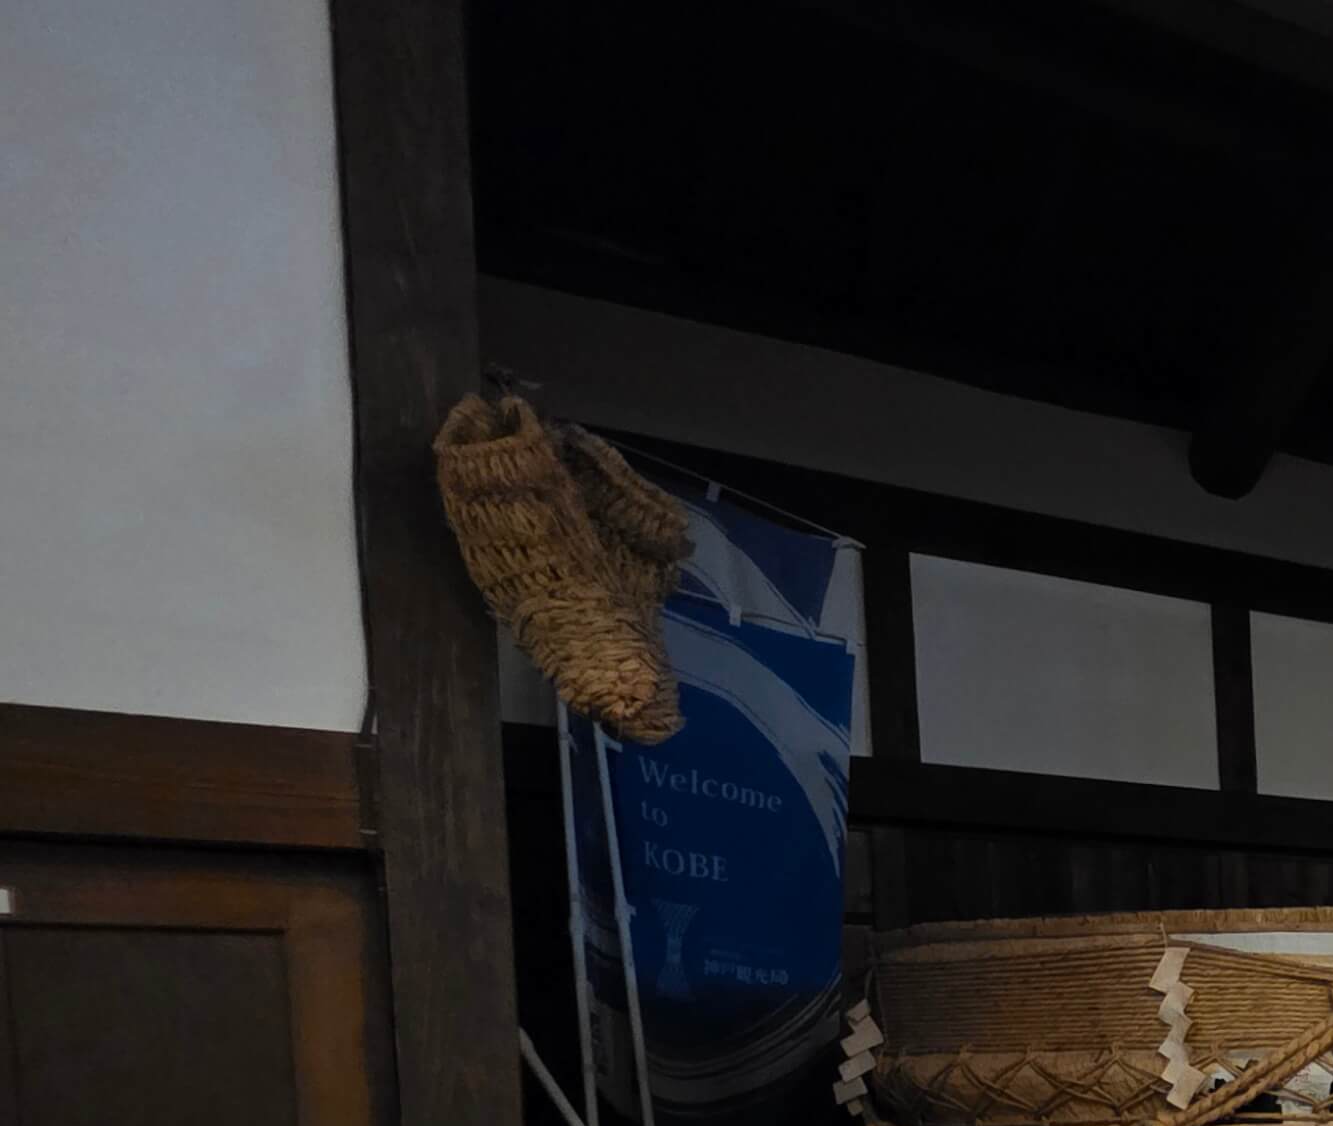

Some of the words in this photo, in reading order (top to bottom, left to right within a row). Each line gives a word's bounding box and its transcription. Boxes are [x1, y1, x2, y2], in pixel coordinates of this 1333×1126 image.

[637, 754, 784, 814] Welcome
[640, 801, 669, 828] to
[642, 841, 729, 882] KOBE
